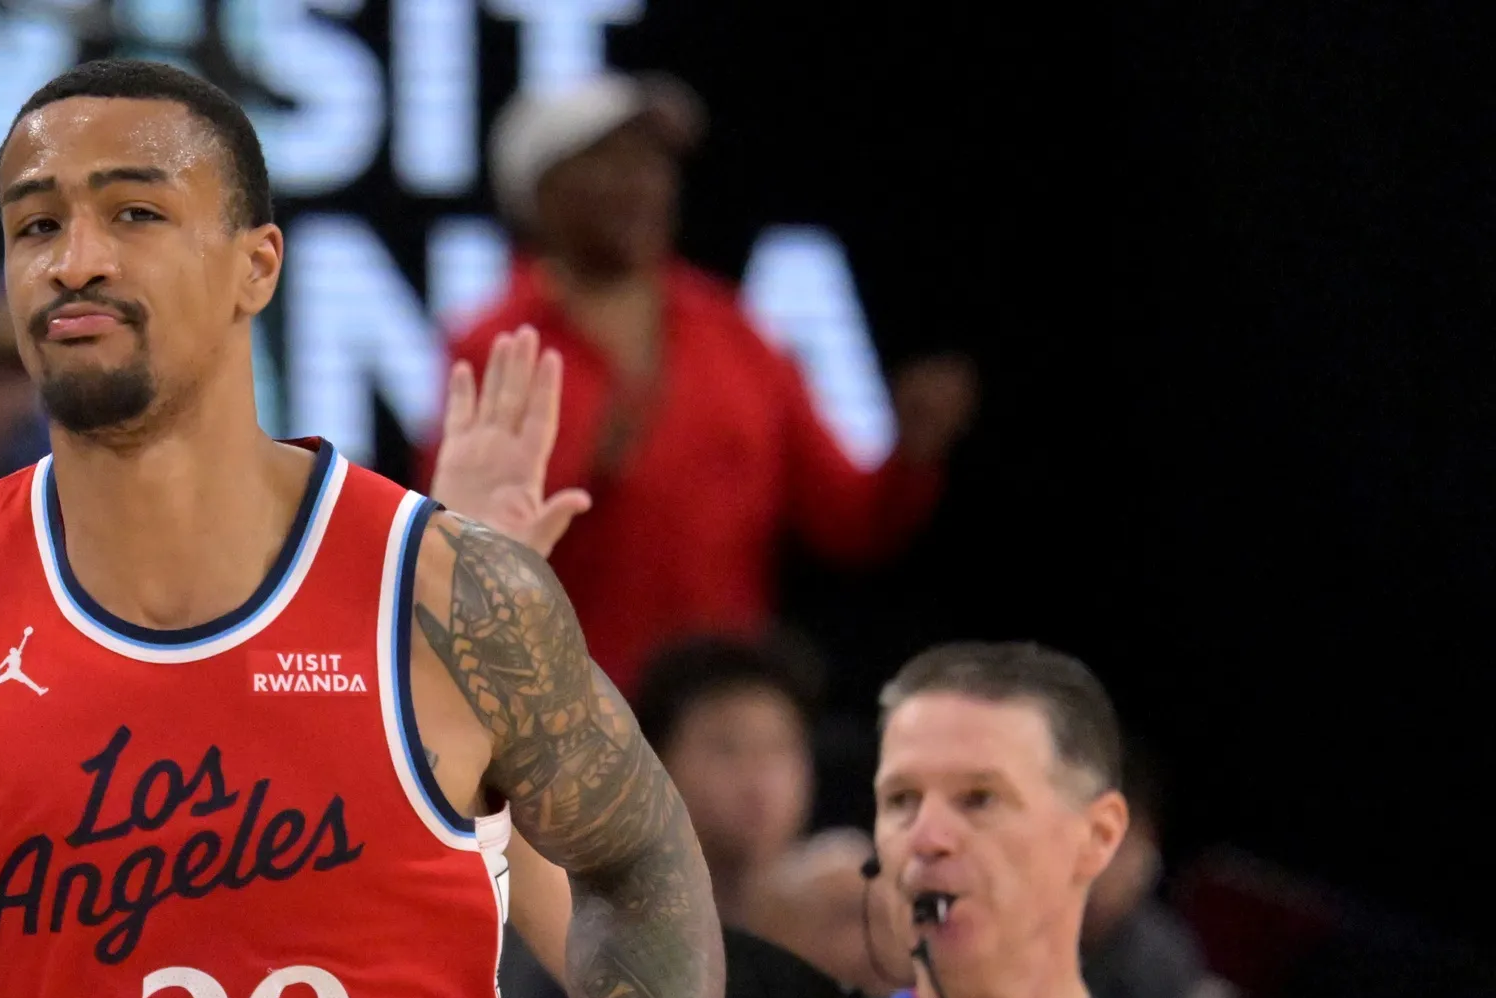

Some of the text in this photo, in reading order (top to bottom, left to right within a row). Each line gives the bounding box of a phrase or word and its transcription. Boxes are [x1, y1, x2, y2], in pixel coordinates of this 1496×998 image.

[276, 653, 342, 672] VISIT
[252, 673, 368, 692] RWANDA
[66, 724, 239, 849] Los
